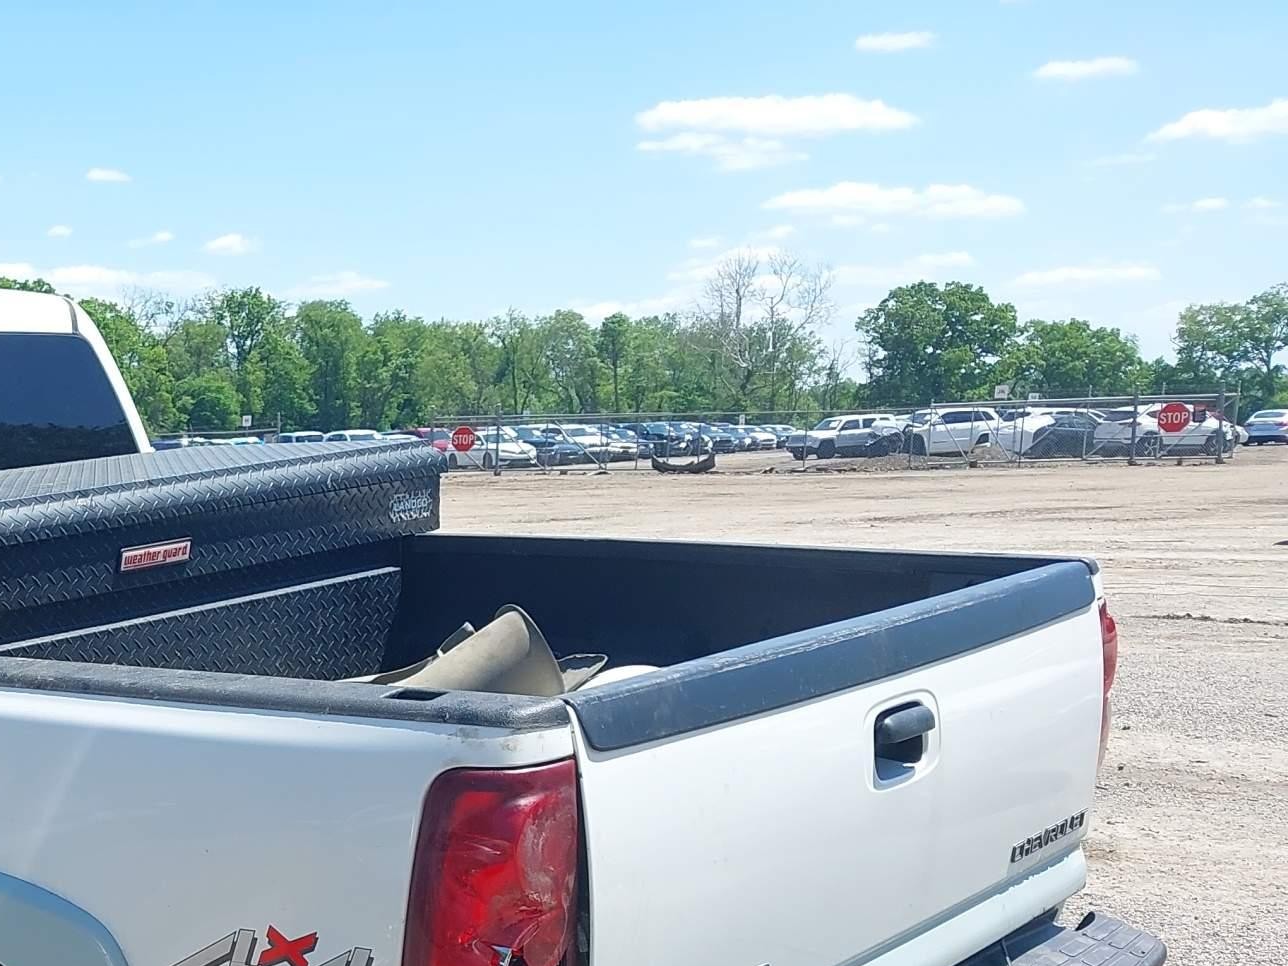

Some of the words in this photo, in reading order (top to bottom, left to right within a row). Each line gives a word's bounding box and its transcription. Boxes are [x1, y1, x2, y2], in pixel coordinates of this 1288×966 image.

[1159, 411, 1189, 424] STOP
[453, 434, 474, 445] STOP
[124, 549, 162, 566] weather
[163, 543, 189, 560] guard
[1010, 808, 1088, 863] CHEVROLET
